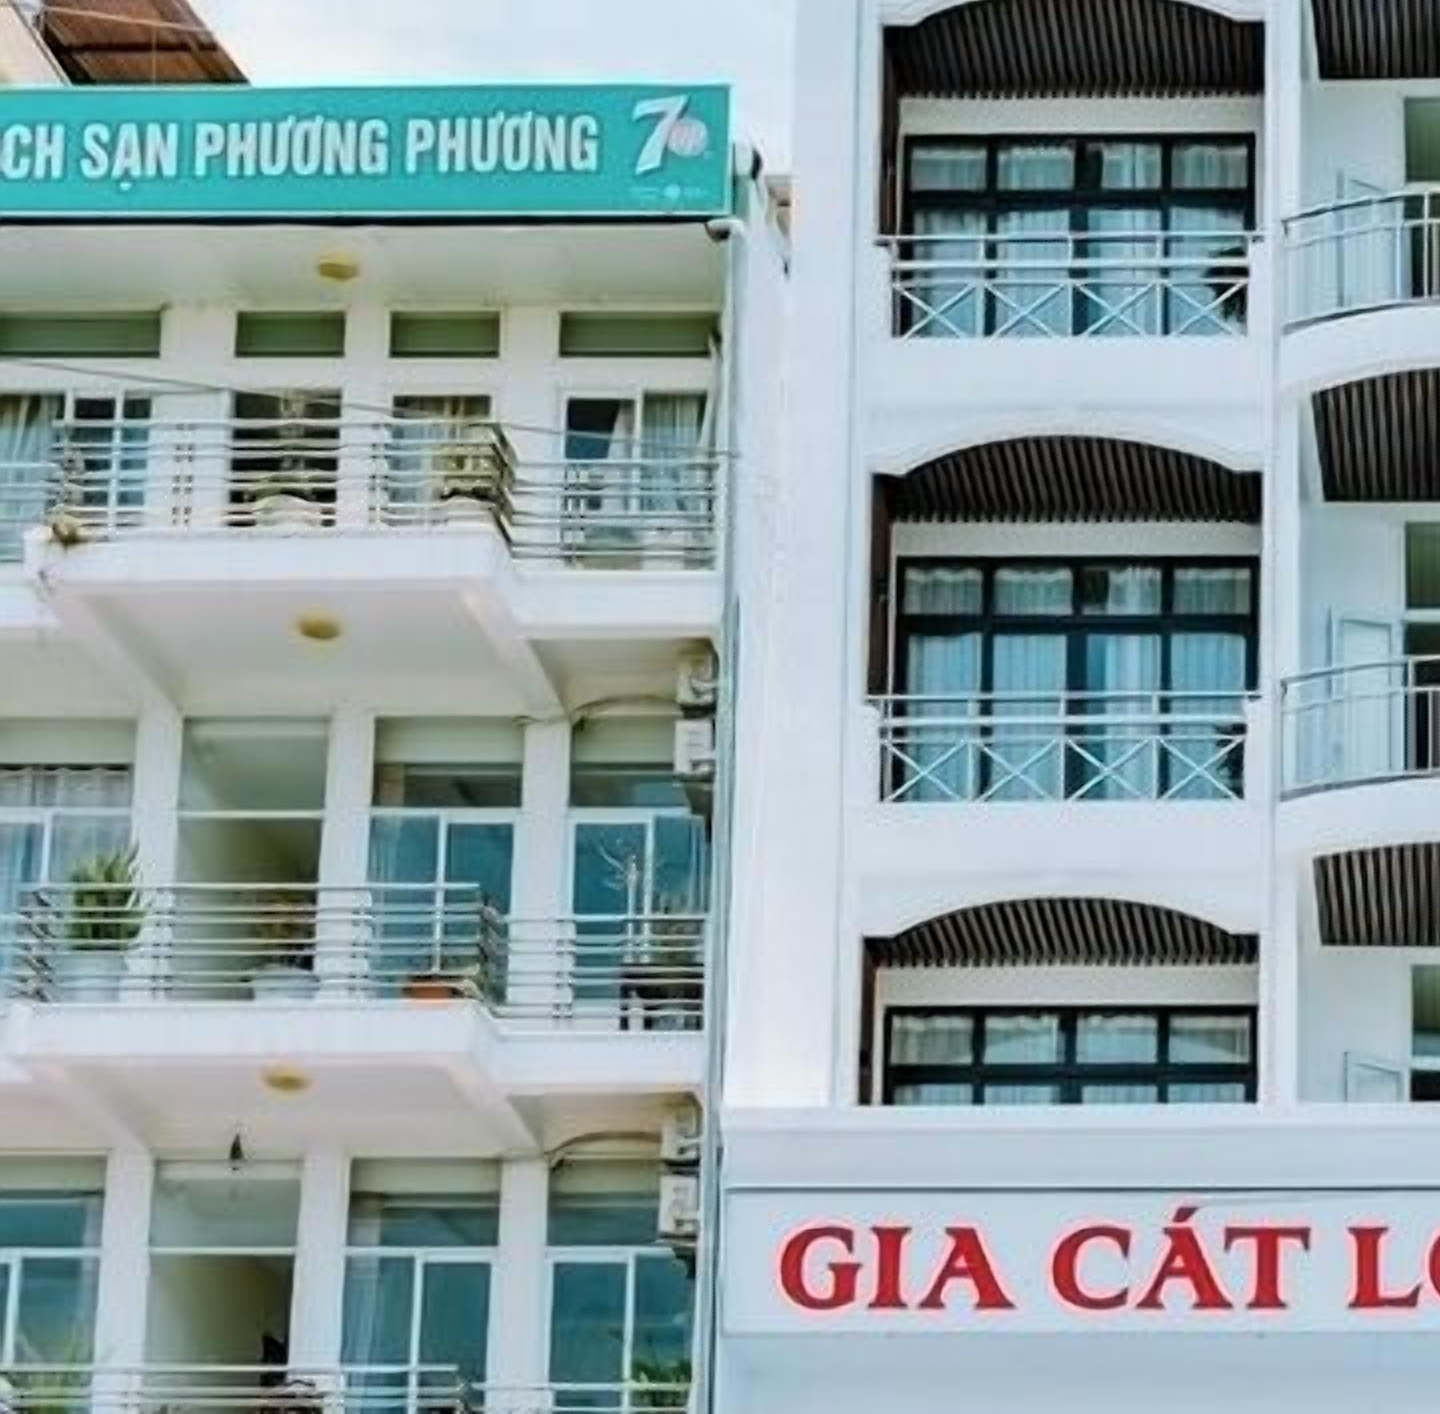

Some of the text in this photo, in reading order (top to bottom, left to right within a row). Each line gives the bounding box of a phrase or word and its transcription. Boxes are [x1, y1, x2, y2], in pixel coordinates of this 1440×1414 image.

[81, 122, 178, 191] SẠN
[195, 115, 388, 177] PHƯƠNG
[406, 110, 598, 173] PHƯƠNG
[780, 1226, 1016, 1310] GIA
[1051, 1206, 1310, 1310] CÁT
